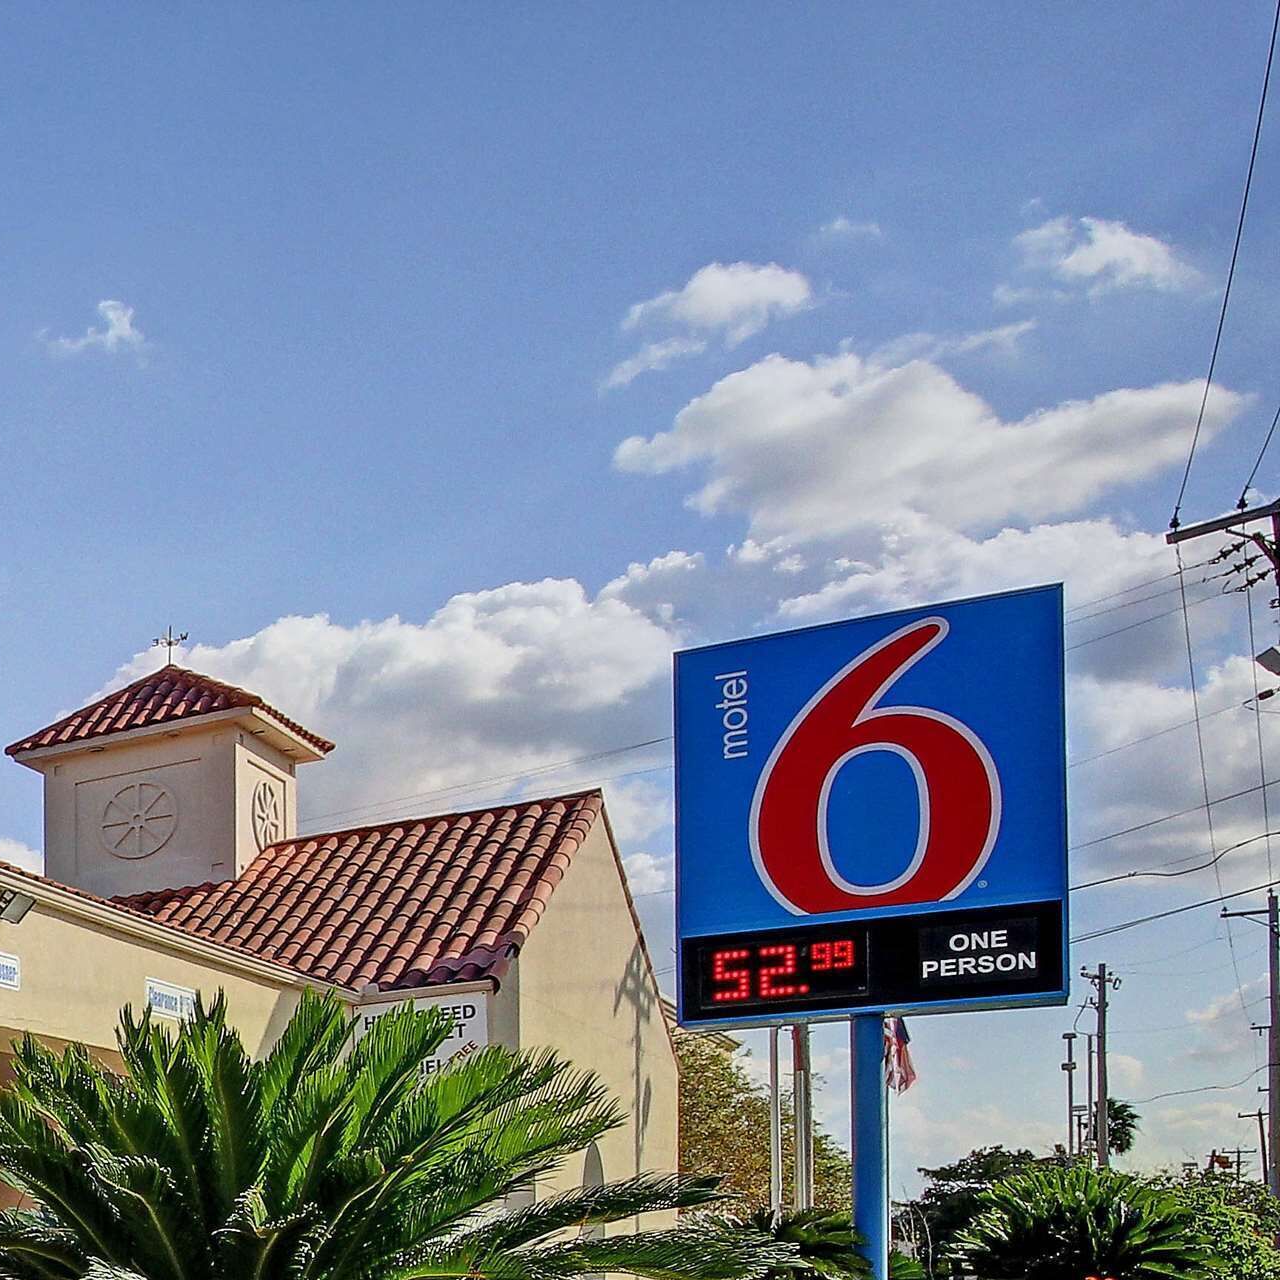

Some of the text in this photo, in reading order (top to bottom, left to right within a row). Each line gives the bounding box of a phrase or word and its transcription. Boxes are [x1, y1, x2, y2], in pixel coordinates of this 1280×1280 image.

[715, 670, 748, 760] motel
[748, 615, 1002, 916] 6
[922, 951, 1036, 979] PERSON
[949, 929, 1008, 952] ONE
